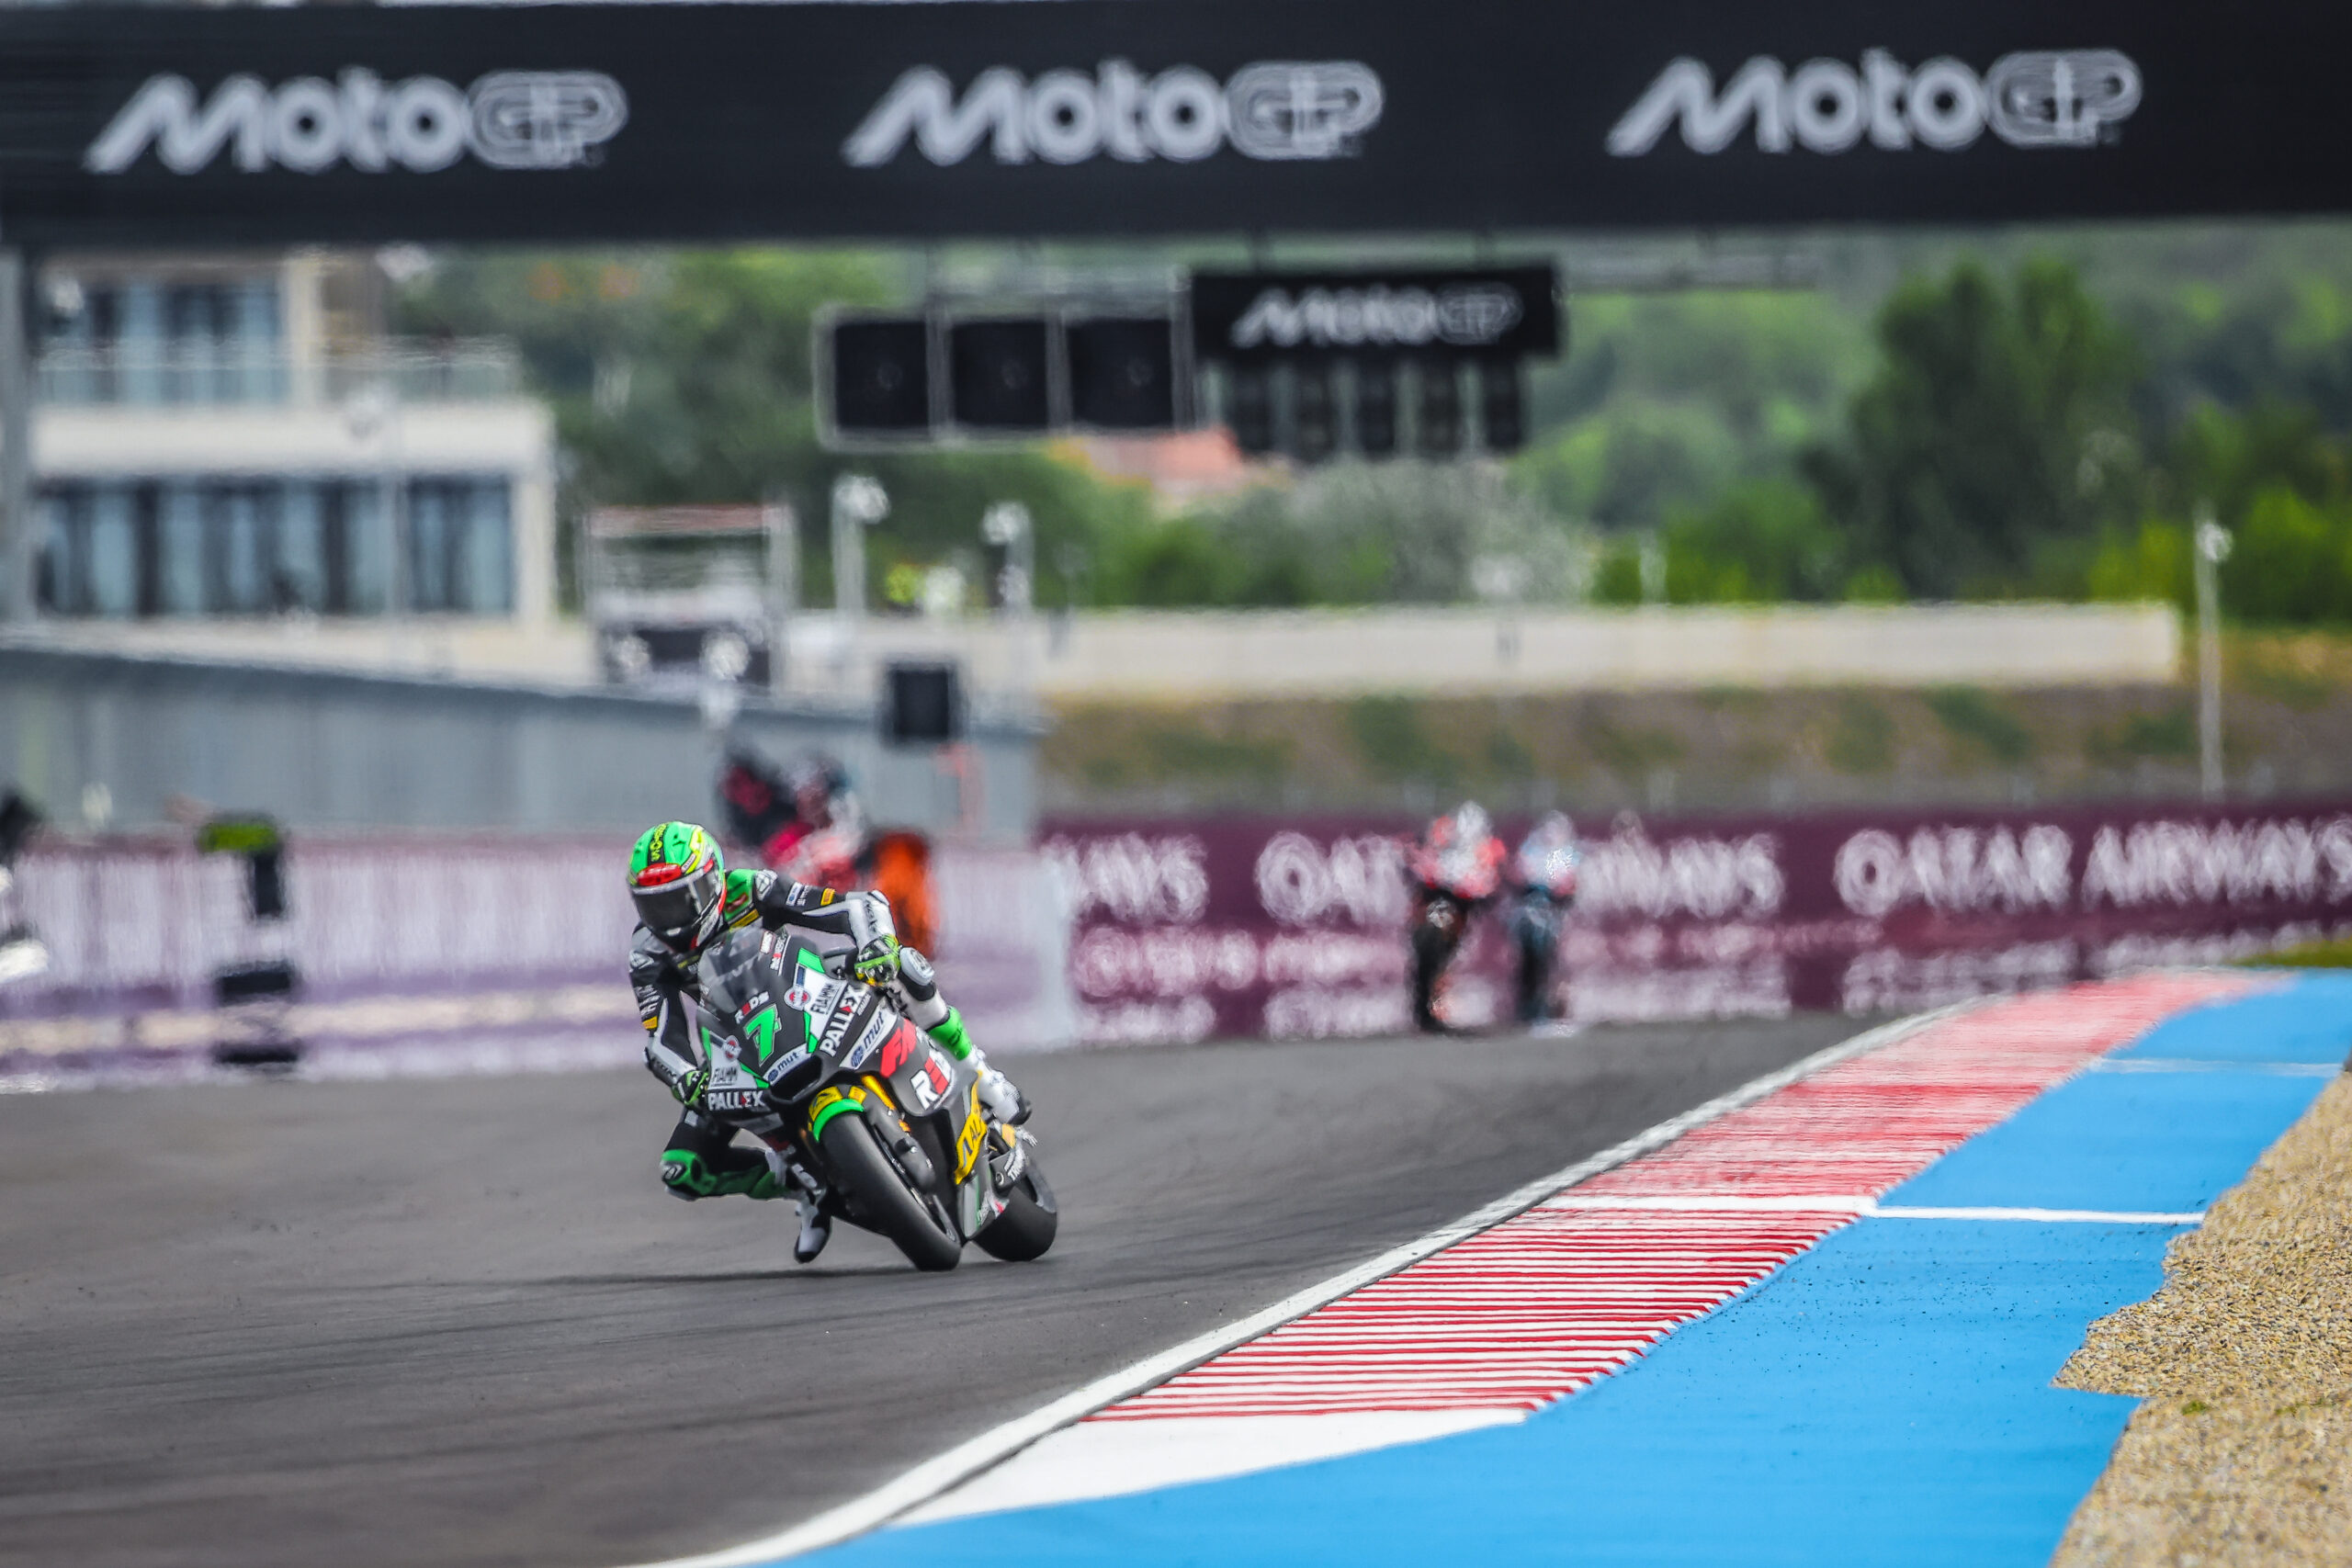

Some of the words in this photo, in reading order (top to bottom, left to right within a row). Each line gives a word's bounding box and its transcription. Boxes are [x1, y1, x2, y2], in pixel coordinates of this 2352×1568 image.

[84, 66, 628, 175] MotoGP
[842, 57, 1383, 167] MotoGP
[1604, 47, 2143, 157] MotoGP
[1231, 282, 1523, 349] MotoGP
[820, 984, 866, 1057] PALLEX
[777, 1052, 799, 1071] mut
[707, 1090, 765, 1111] PALLEX
